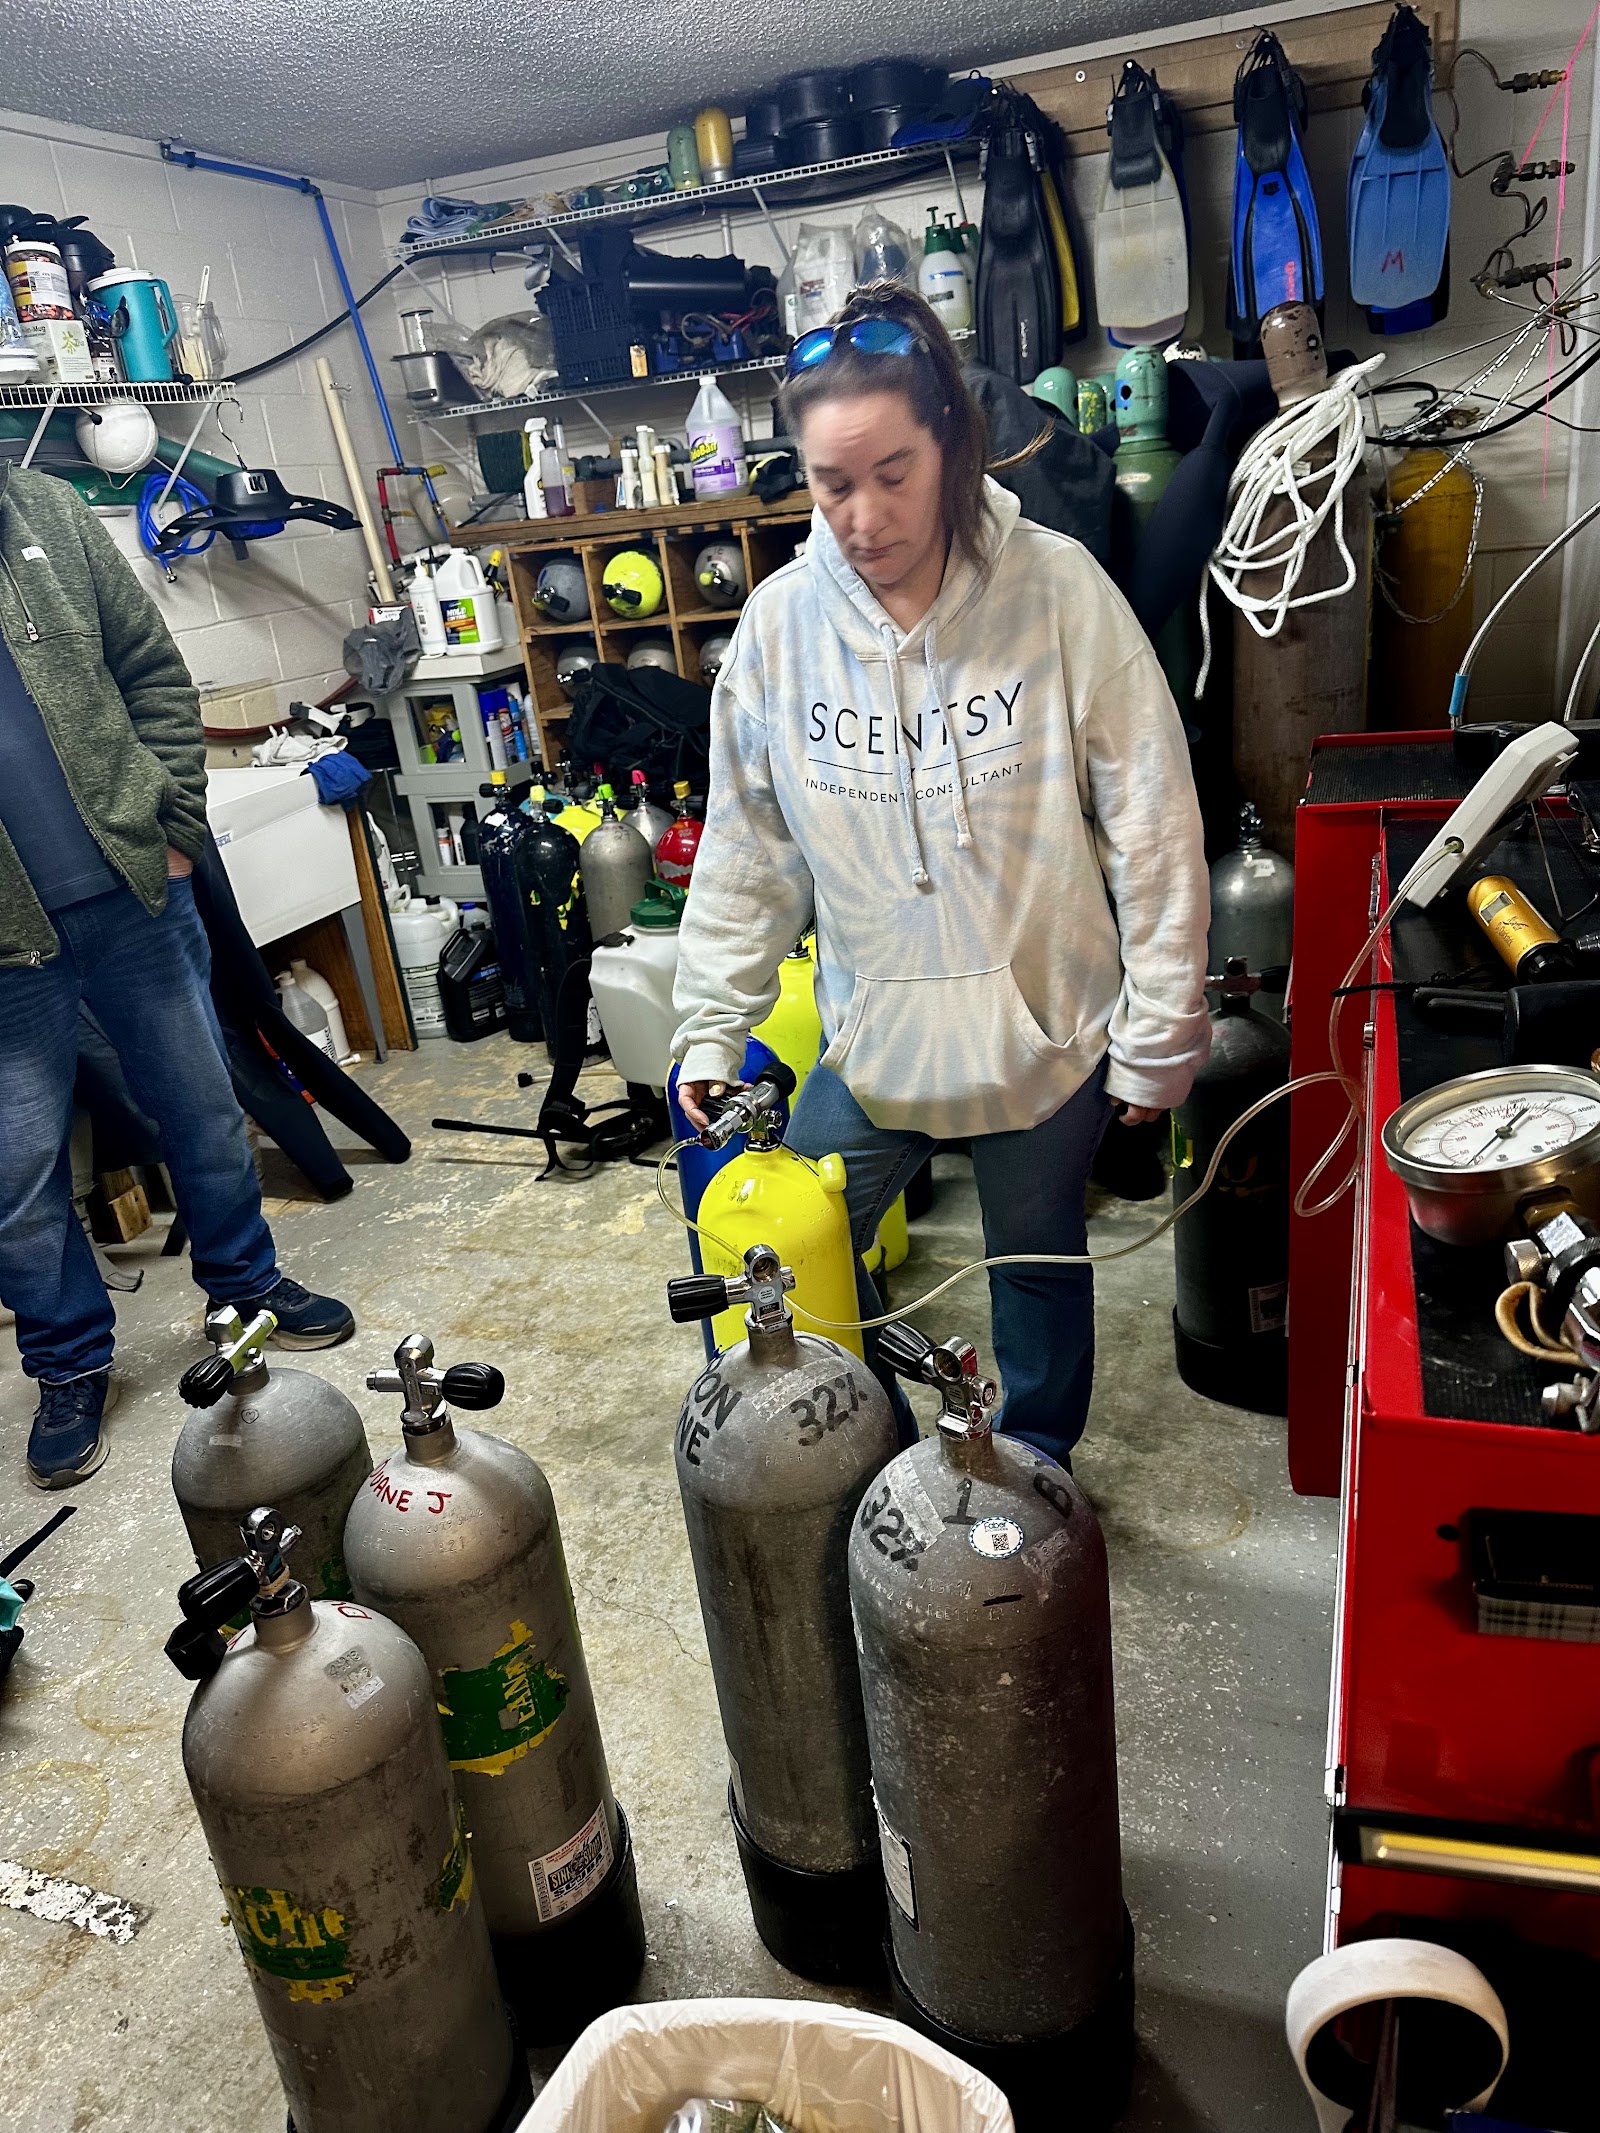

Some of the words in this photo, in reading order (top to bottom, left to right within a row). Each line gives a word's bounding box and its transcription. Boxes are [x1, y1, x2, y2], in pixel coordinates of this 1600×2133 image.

[1382, 250, 1404, 273] M
[446, 607, 467, 616] MOLD
[809, 681, 1023, 755] SCENTSY
[915, 763, 1023, 801] CONSULTANT
[790, 1372, 868, 1446] 32%
[427, 1491, 452, 1514] J
[942, 1477, 980, 1525] 1
[550, 1867, 574, 1889] SINK
[552, 1854, 604, 1898] SCUBA
